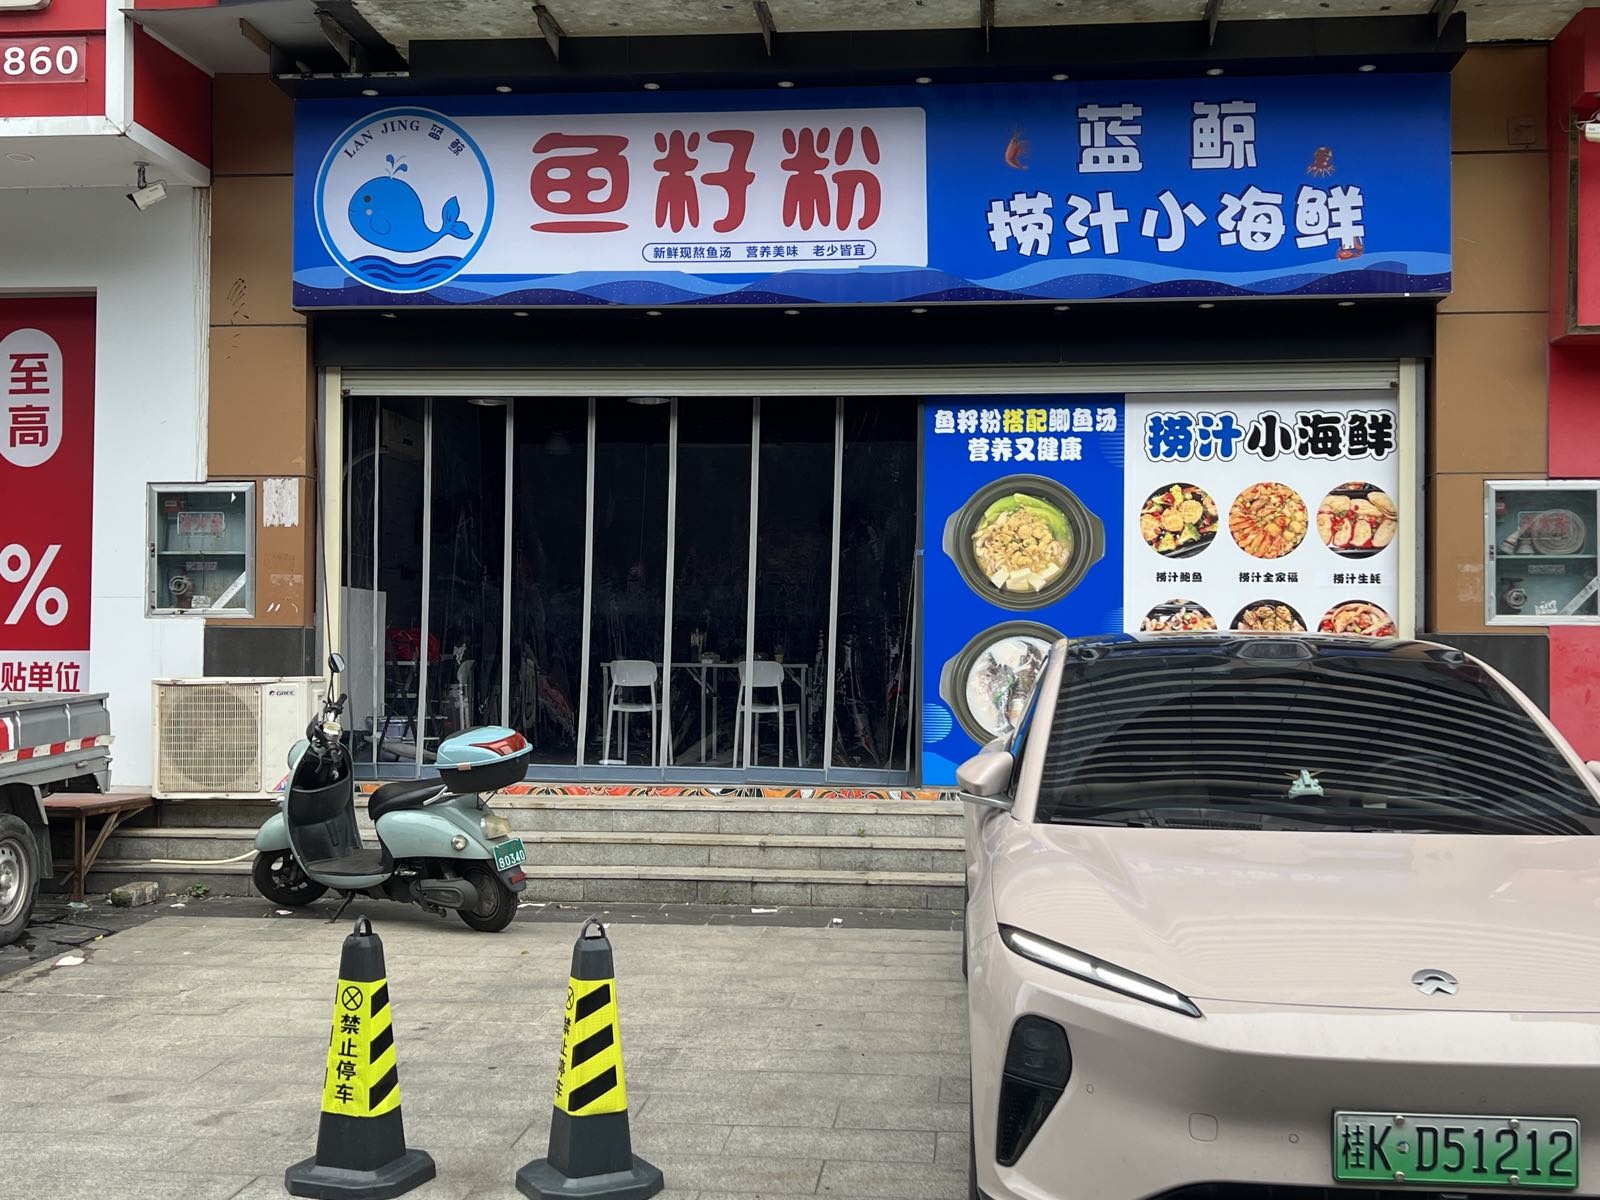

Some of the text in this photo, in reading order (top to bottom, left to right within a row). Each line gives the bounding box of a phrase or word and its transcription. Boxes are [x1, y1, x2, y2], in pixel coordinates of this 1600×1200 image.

[3, 45, 78, 75] 860
[343, 130, 374, 158] LAN
[381, 119, 420, 134] JING
[1077, 100, 1257, 173] 蓝鲸
[530, 126, 882, 234] 鱼籽粉
[987, 185, 1365, 257] 捞汁小海鲜
[652, 244, 866, 259] 新鲜现熬鱼汤 营养美味 老少皆宜
[8, 353, 50, 448] 至高
[934, 408, 1117, 433] 鱼籽粉搭配鲫鱼汤
[1146, 412, 1395, 460] 捞汁小海鲜
[968, 436, 1082, 462] 营养又健康
[1155, 571, 1203, 583] 捞汁鲍鱼
[1238, 571, 1299, 583] 捞汁全家福
[0, 661, 80, 692] 贴单位
[498, 849, 526, 868] 80340
[334, 1013, 361, 1104] 禁止停车
